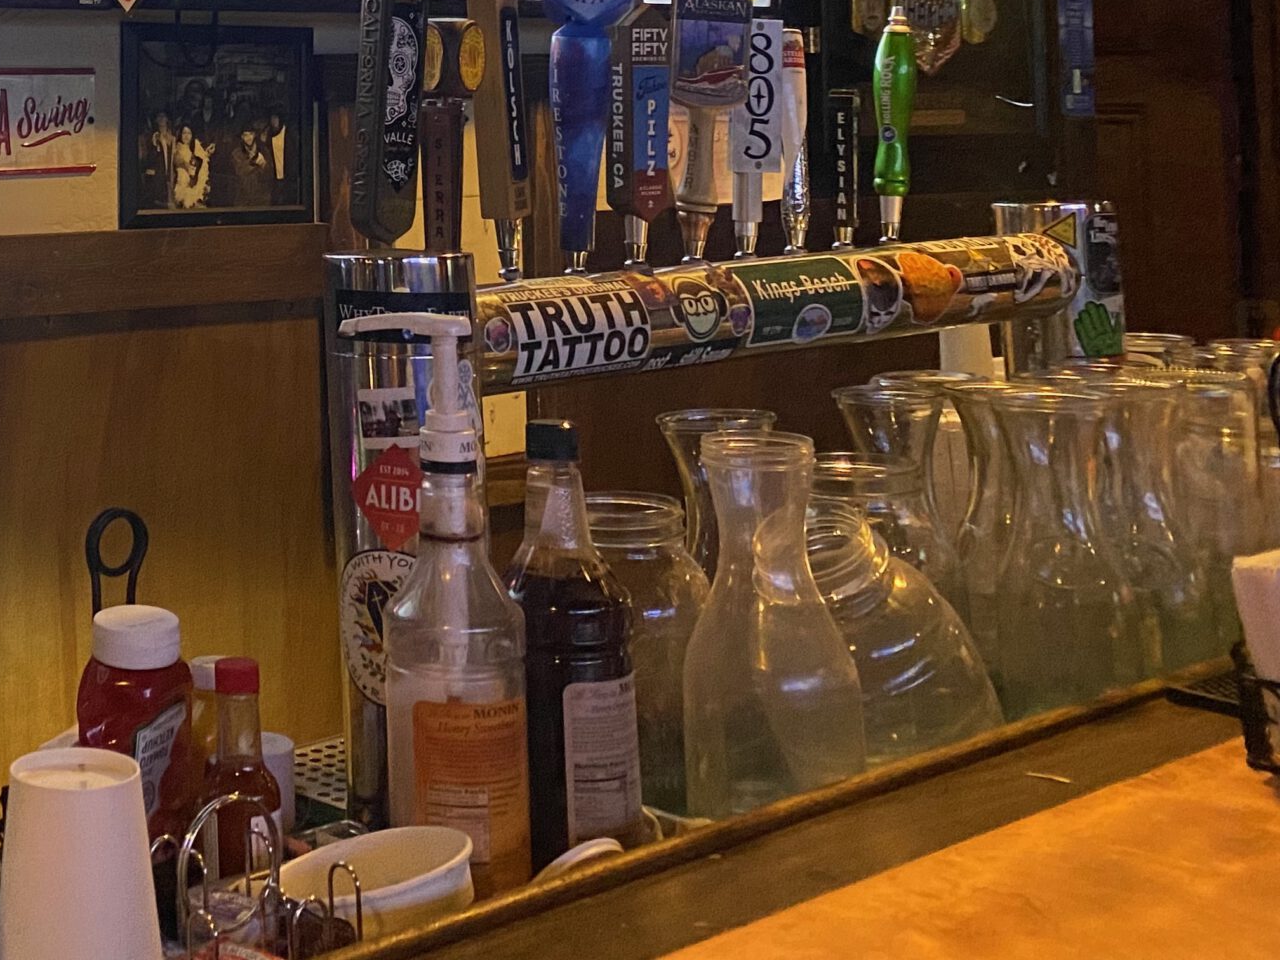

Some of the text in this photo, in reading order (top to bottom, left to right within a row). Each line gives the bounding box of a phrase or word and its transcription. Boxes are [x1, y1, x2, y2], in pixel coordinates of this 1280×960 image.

[632, 28, 668, 42] FIFTY
[632, 42, 667, 56] FIFTY
[880, 55, 895, 124] ROLLING ROCK
[384, 133, 413, 146] VALLE
[552, 38, 567, 217] FIRESTONE
[612, 63, 624, 189] TRUCKEE, CA
[647, 99, 656, 176] PILZ
[434, 138, 444, 238] SIERRA
[837, 112, 847, 221] ELYSIAN
[498, 287, 572, 303] TRUCKEE'S
[573, 279, 631, 295] ORIGINAL
[752, 272, 850, 304] Kings Beach
[507, 291, 648, 340] TRUTH
[520, 327, 649, 373] TATTOO
[350, 554, 383, 570] WITH
[474, 704, 519, 719] MONIN
